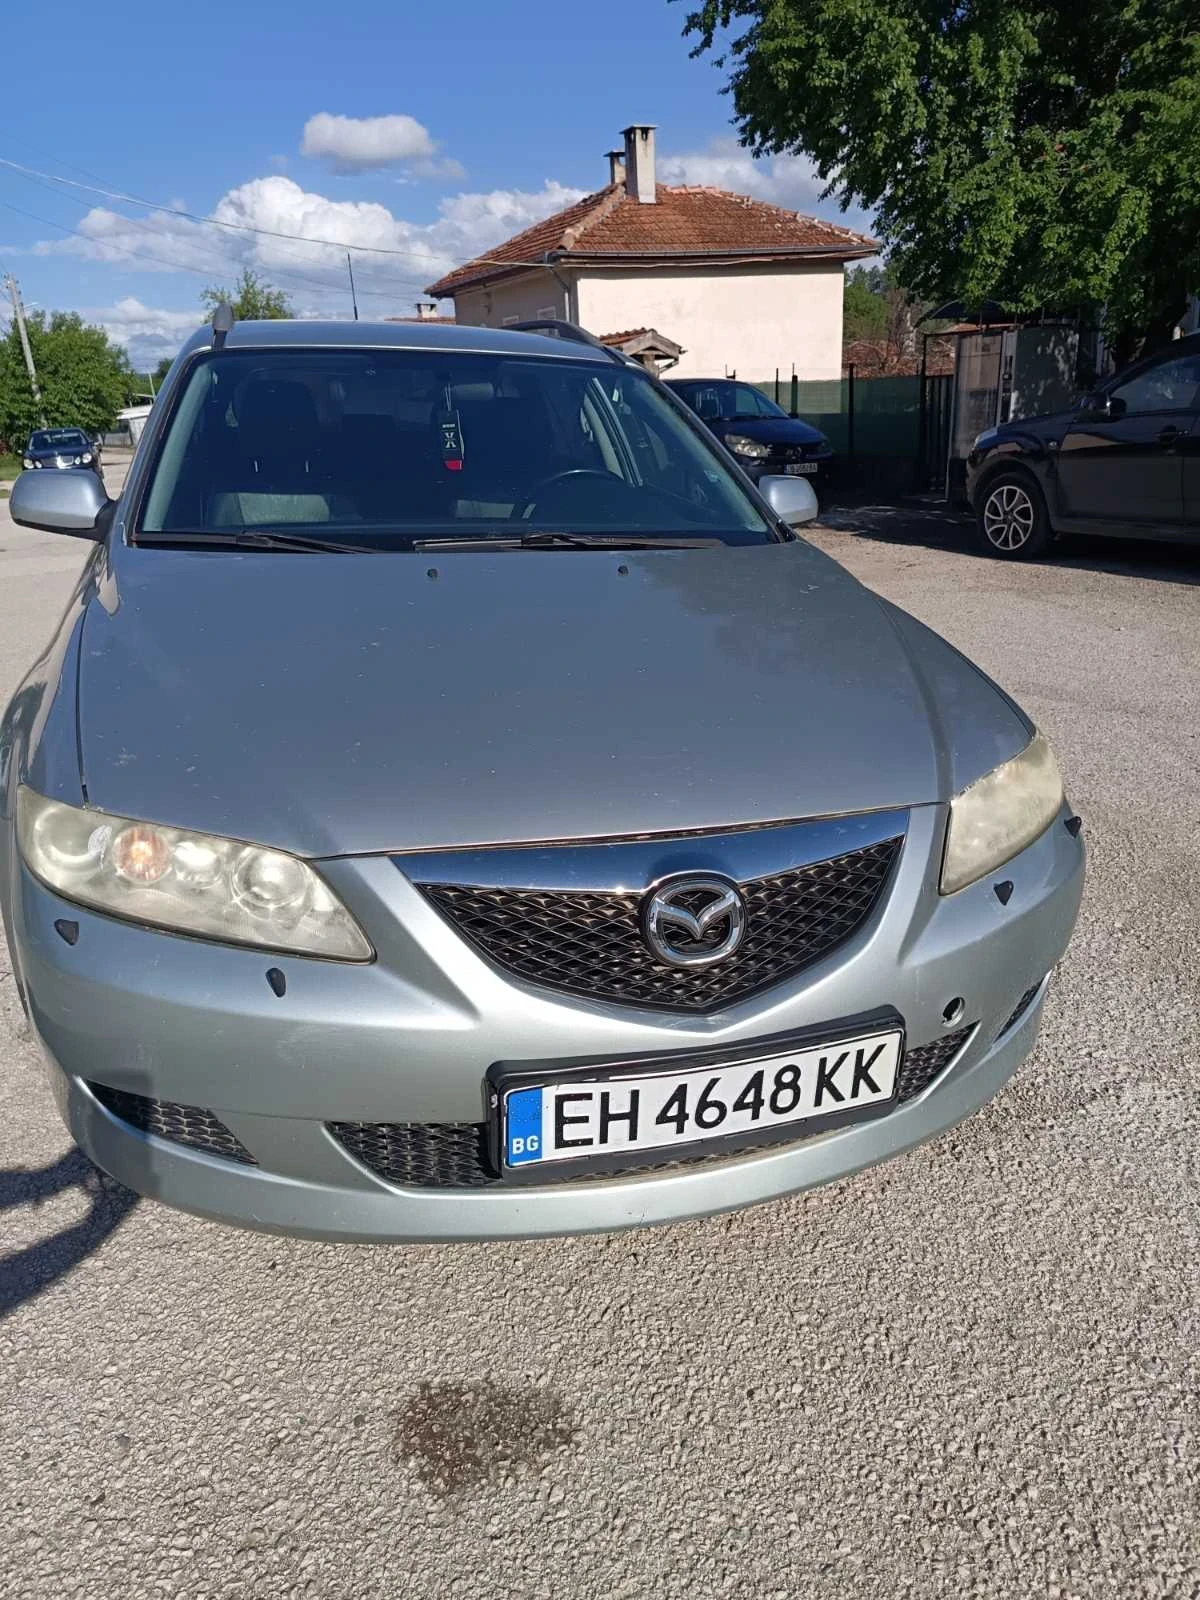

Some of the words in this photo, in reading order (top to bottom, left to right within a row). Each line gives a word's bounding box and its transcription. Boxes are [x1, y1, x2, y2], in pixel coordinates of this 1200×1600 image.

[554, 1090, 640, 1149] EH
[655, 1064, 802, 1134] 4648
[814, 1044, 887, 1107] KK
[512, 1135, 539, 1154] BG
